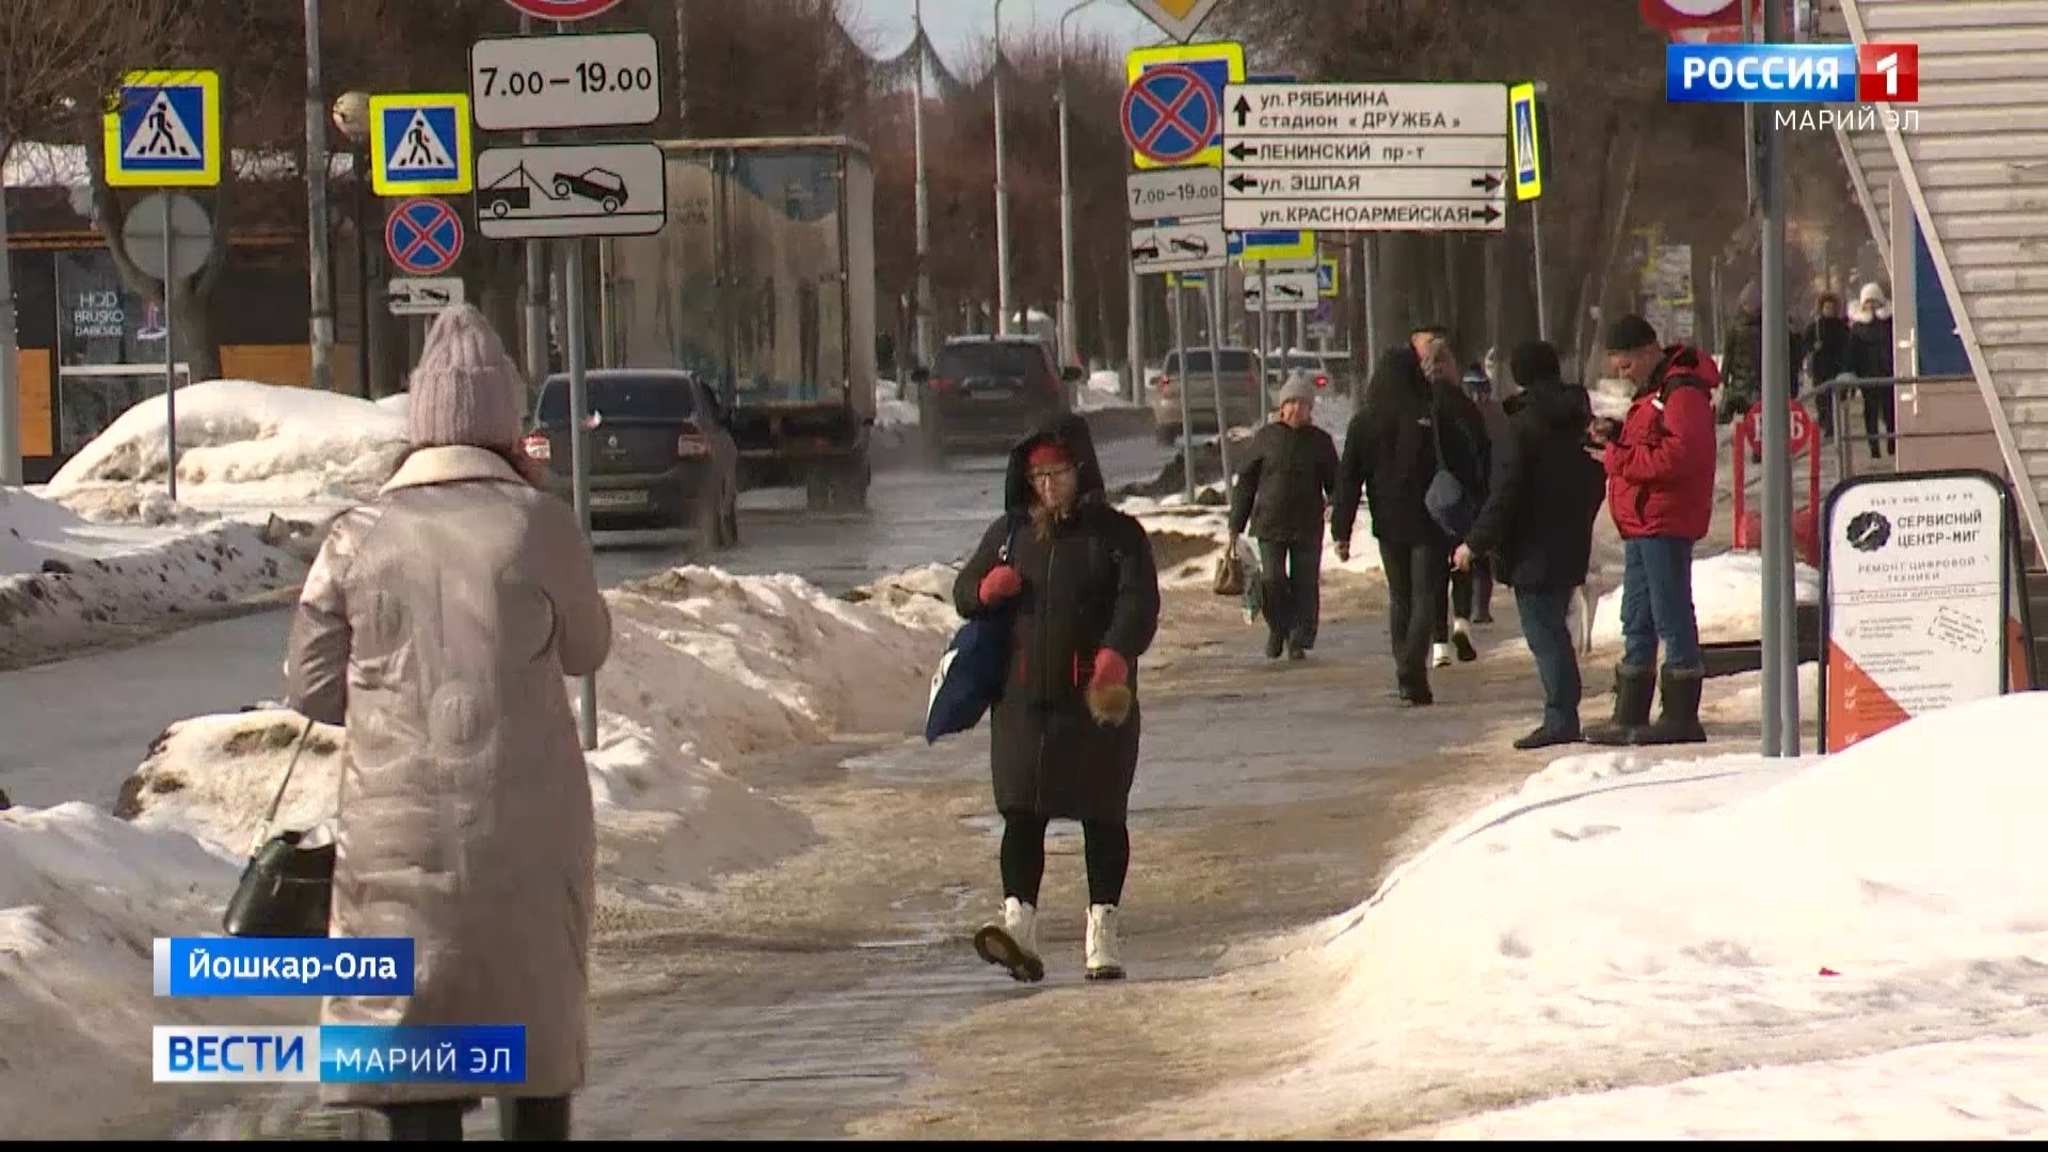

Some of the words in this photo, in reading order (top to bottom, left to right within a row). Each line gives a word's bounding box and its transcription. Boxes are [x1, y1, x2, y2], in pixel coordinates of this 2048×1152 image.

[1259, 115, 1338, 129] стадион
[1260, 140, 1371, 159] ЛЕНИНСКИЙ
[1382, 146, 1425, 159] пр-т
[1260, 179, 1284, 193] ул.
[1290, 175, 1361, 191] ЭШПАЯ
[74, 310, 124, 323] BRUSKO
[1897, 509, 1982, 529] СЕРВИСНЫЙ
[1897, 530, 1981, 548] ЦЕНТР-МИГ
[1858, 561, 1905, 574] РЕМОНТ
[1909, 556, 1976, 572] ЦИФРОВОЙ
